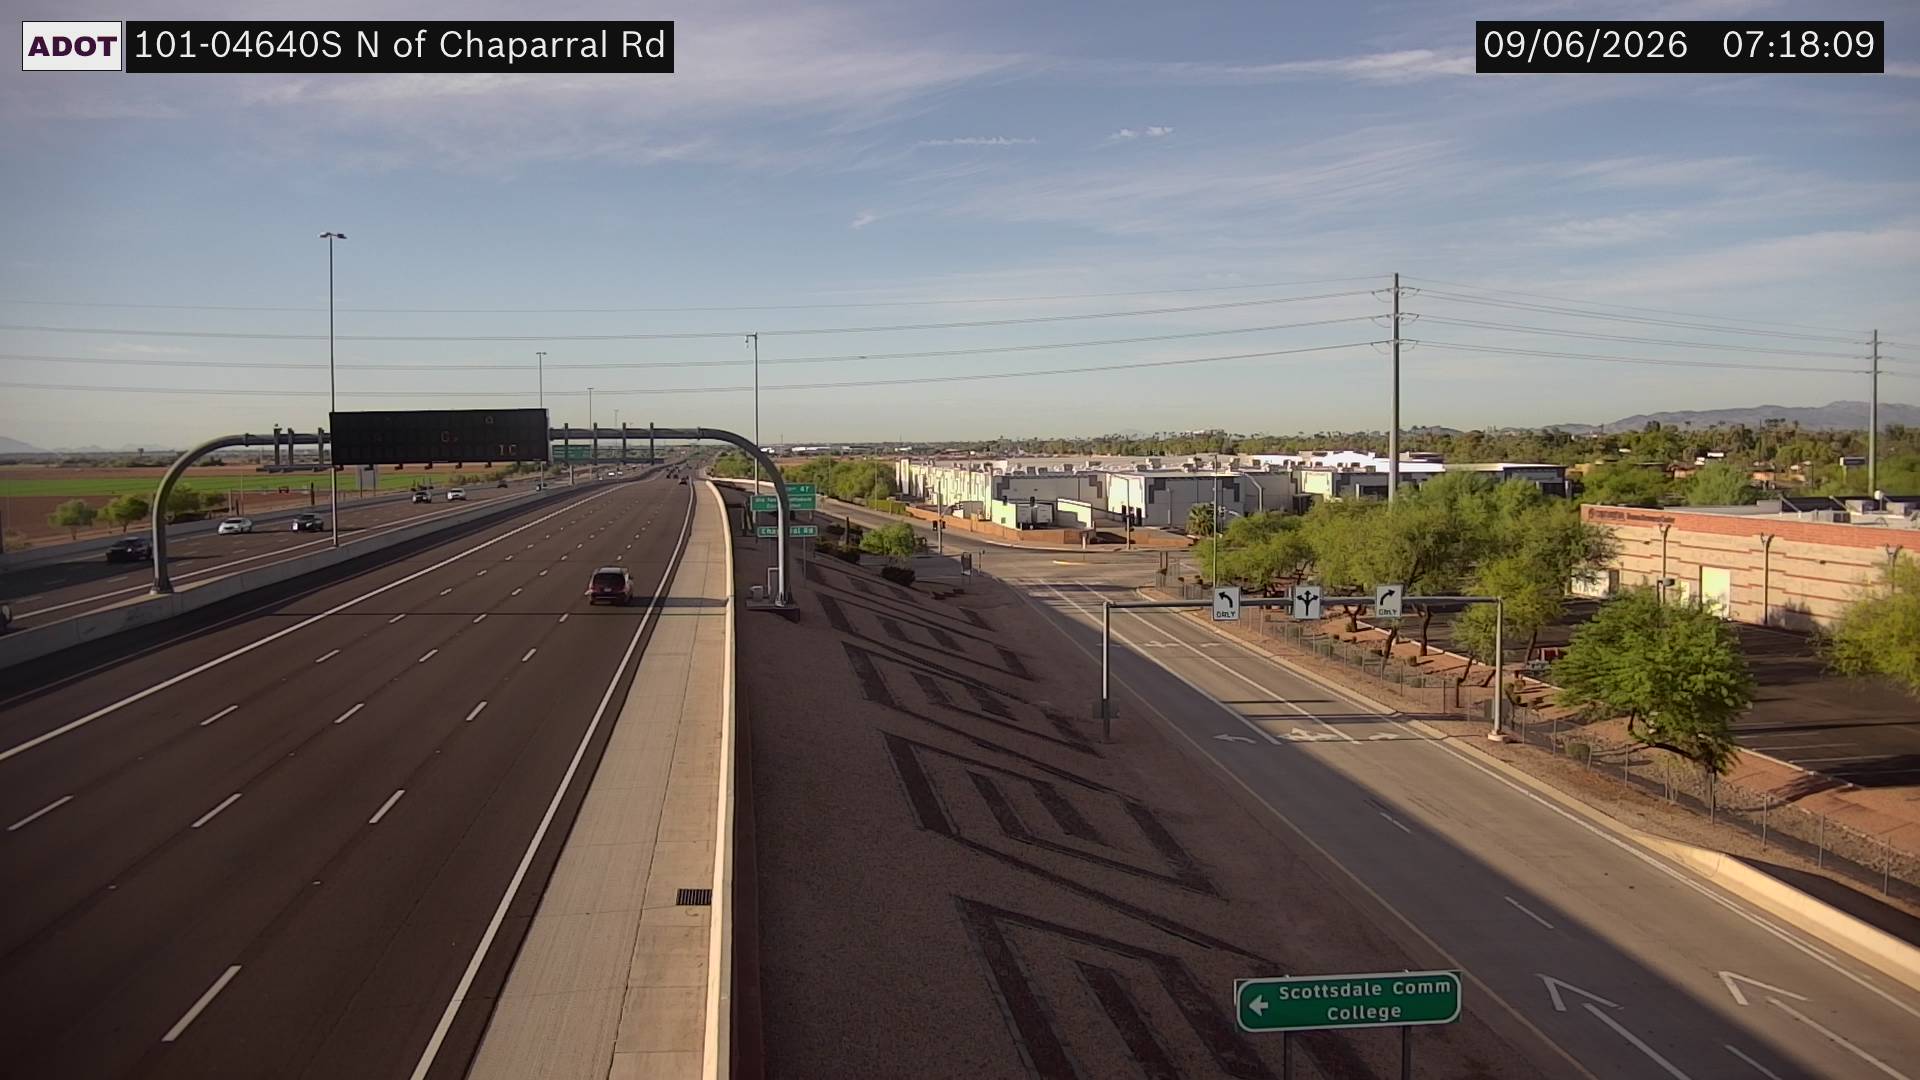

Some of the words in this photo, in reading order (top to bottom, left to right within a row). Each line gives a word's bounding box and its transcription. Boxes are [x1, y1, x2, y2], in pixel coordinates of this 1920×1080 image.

[1279, 982, 1382, 1000] Scottsdale
[1393, 982, 1450, 994] Comm
[1327, 1006, 1402, 1022] College
